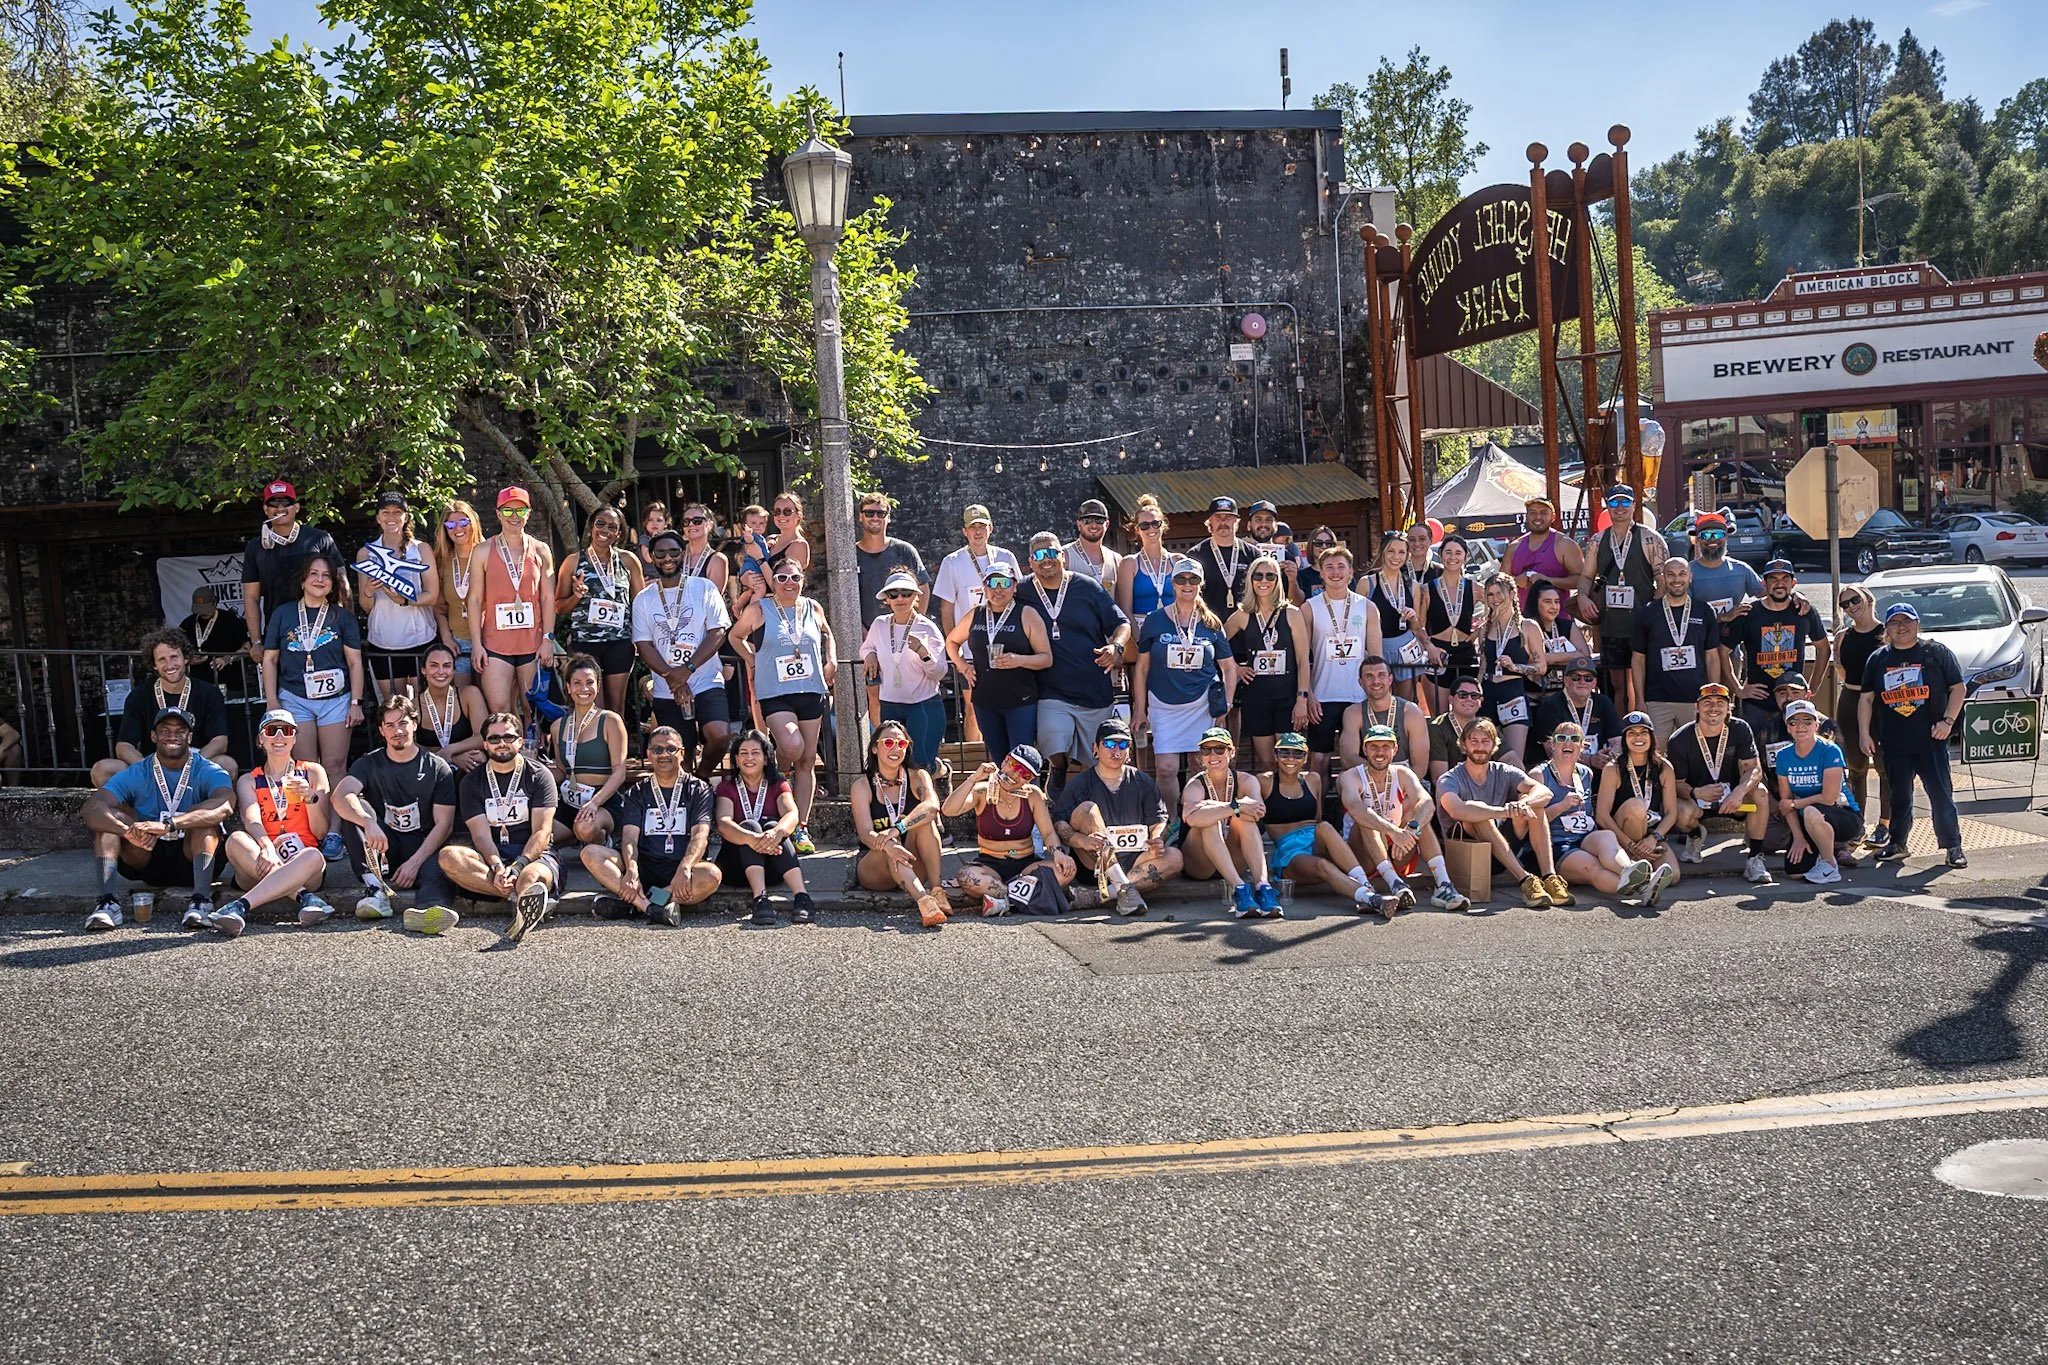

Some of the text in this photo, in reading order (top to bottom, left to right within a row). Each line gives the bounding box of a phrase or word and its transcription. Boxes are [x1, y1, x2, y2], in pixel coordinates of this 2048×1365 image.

[1798, 272, 1919, 293] AMERICAN BLOCK.
[1882, 341, 2014, 364] RESTAURANT
[1714, 354, 1835, 378] BREWERY
[1612, 592, 1624, 604] 11
[506, 612, 524, 624] 10
[674, 649, 692, 663] 98
[1336, 644, 1352, 656] 57
[1410, 646, 1422, 659] 12
[787, 664, 804, 676] 68
[1897, 672, 1904, 682] 4
[315, 678, 335, 692] 78
[1511, 705, 1519, 716] 6
[1970, 743, 2032, 758] BIKE VALET
[568, 790, 582, 805] 81
[394, 814, 411, 827] 53
[1571, 817, 1588, 829] 23
[1117, 834, 1137, 847] 69
[279, 841, 298, 859] 65
[1011, 882, 1030, 897] 50
